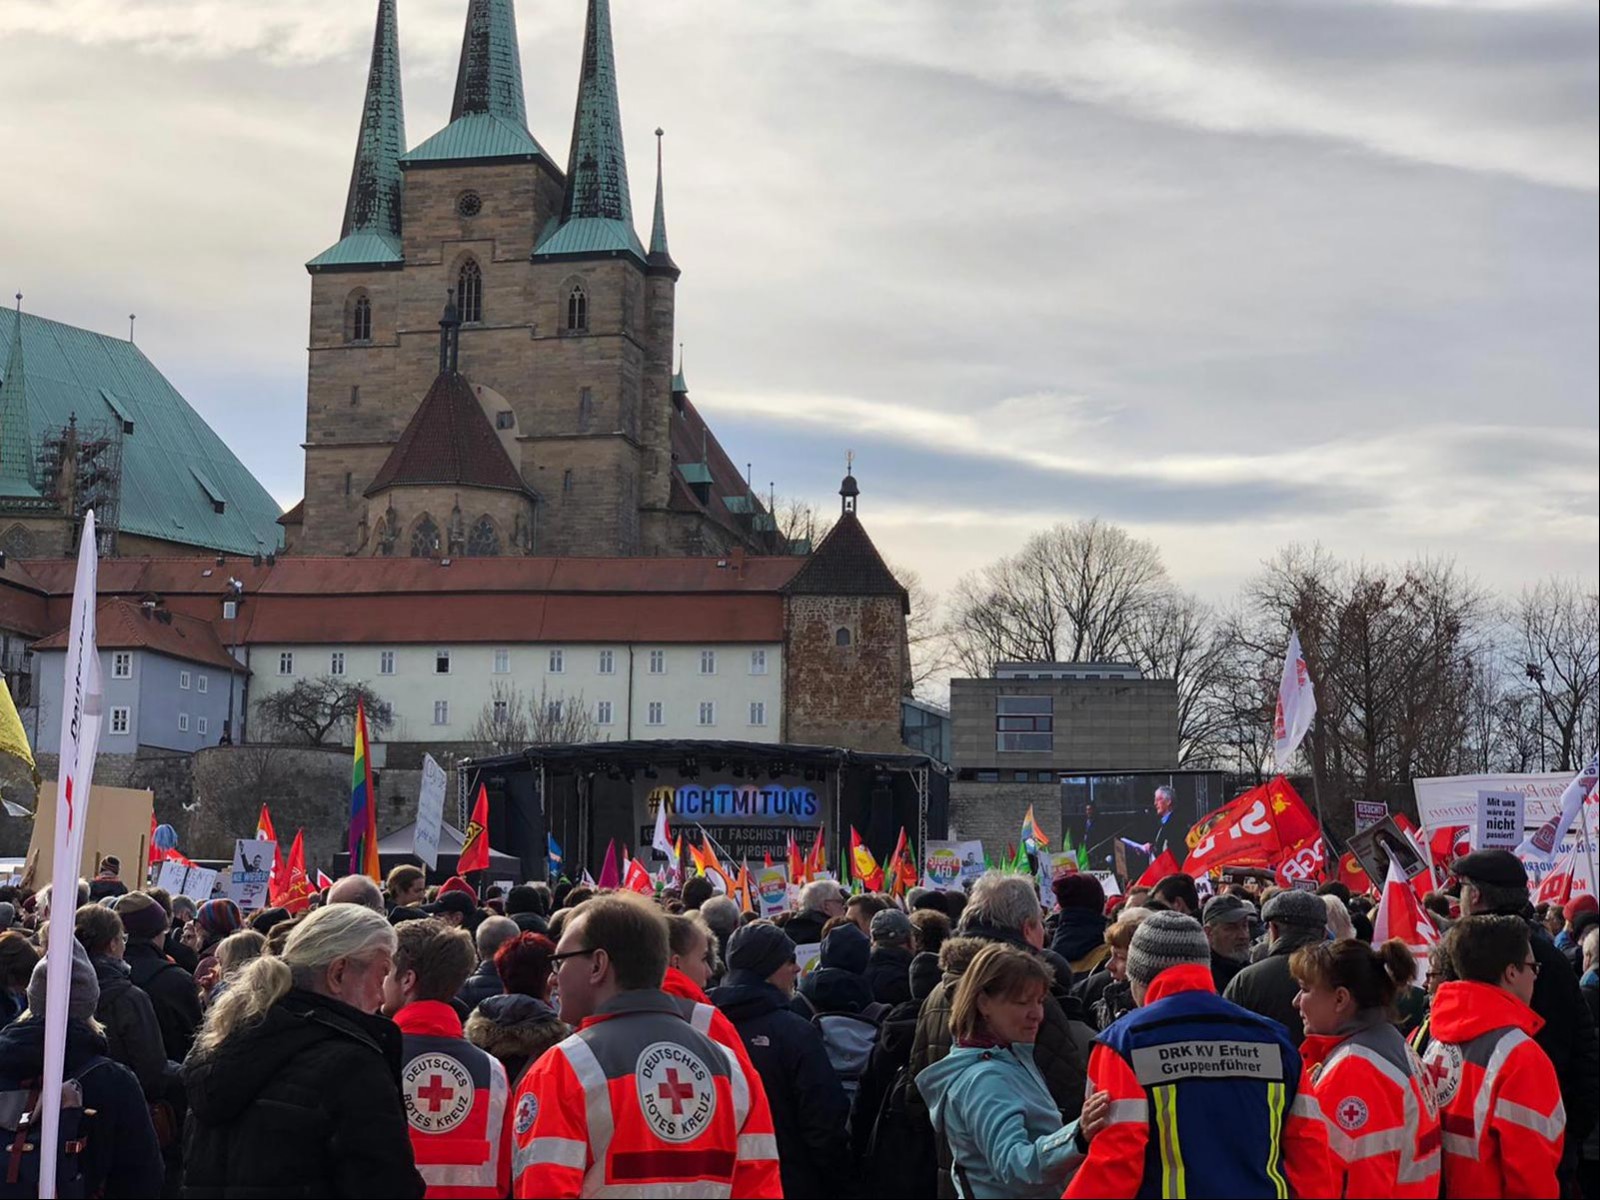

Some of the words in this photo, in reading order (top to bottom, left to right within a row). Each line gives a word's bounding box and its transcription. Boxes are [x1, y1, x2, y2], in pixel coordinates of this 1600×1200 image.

[649, 789, 817, 816] #NICHTMITUNS
[1487, 797, 1500, 806] Mit
[1504, 808, 1515, 816] das
[1486, 817, 1515, 830] nicht
[1159, 1045, 1193, 1060] DRK
[1195, 1045, 1214, 1058] KV
[1220, 1045, 1260, 1058] Erfurt
[406, 1058, 468, 1087] DEUTSCHES
[642, 1048, 705, 1081] DEUTSCHES
[1161, 1059, 1261, 1075] Gruppenführer
[403, 1093, 431, 1127] ROTES
[436, 1095, 469, 1128] KREUZ
[644, 1093, 676, 1134] ROTES
[681, 1091, 711, 1134] KREUZ
